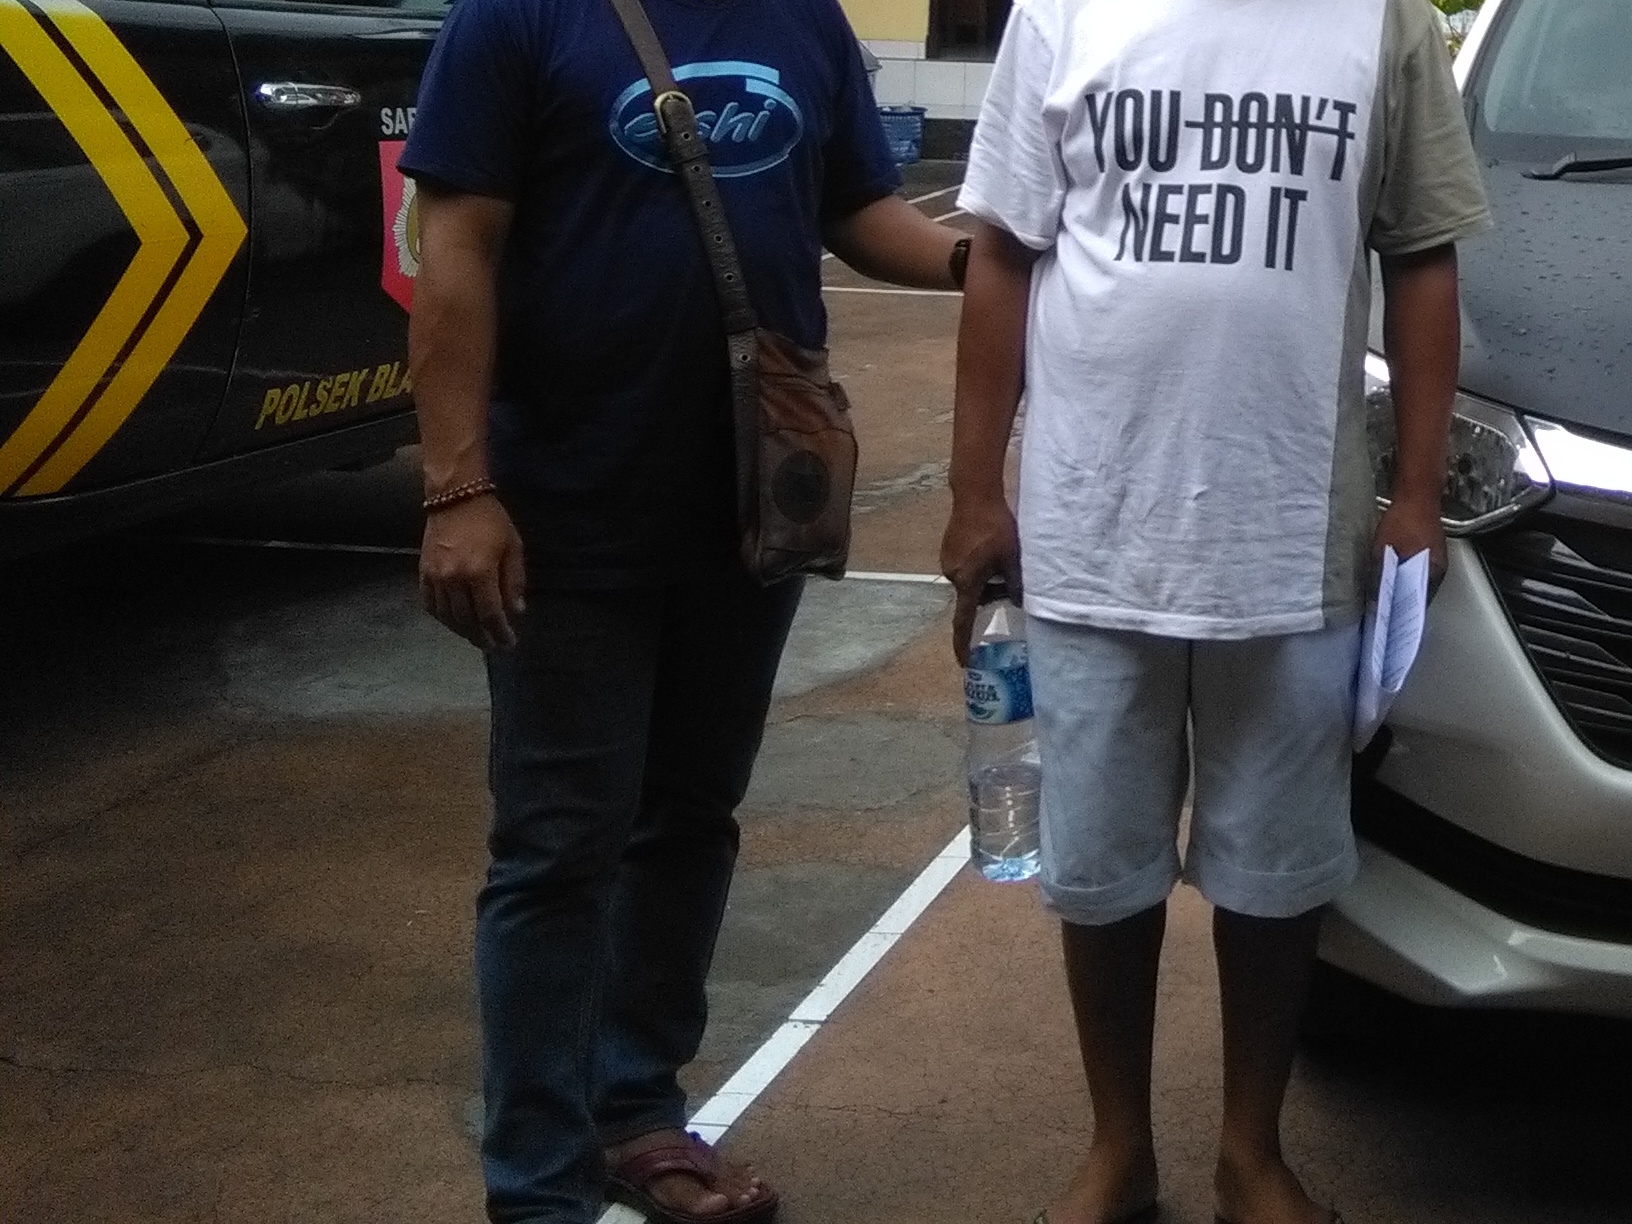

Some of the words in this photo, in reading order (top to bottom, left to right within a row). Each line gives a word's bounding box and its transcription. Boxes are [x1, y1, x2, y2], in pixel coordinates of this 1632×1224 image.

[623, 98, 777, 144] eshi
[1085, 88, 1182, 173] YOU
[1199, 91, 1357, 181] DON'T
[1113, 181, 1247, 265] NEED
[1264, 186, 1309, 271] IT
[254, 368, 370, 431] POLSEK
